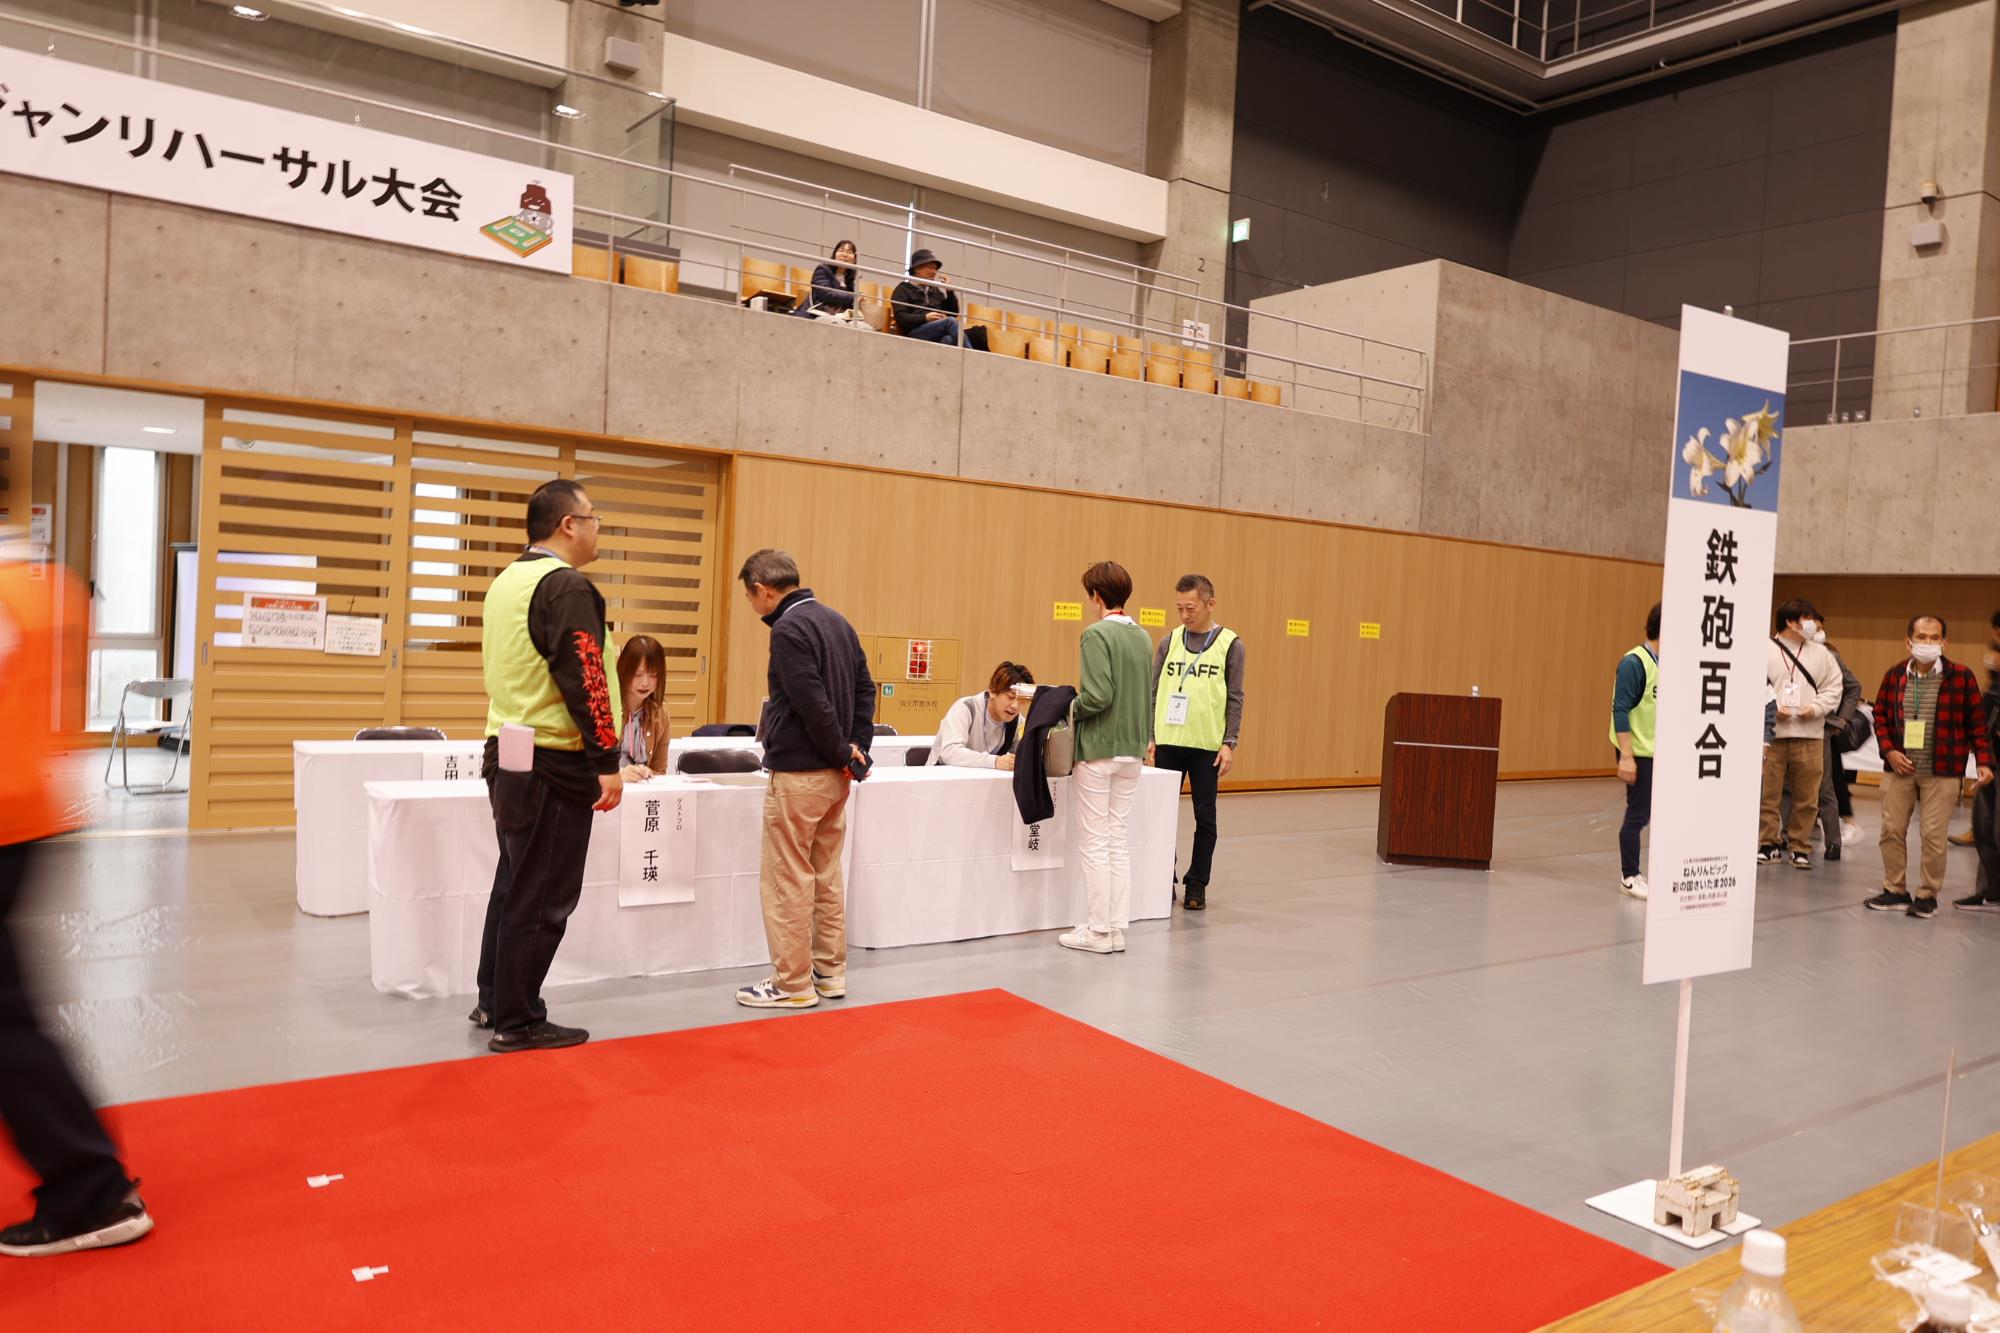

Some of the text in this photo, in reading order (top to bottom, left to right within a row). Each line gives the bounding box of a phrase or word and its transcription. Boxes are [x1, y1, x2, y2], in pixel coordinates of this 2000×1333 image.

[0, 83, 463, 222] ャンリハーサル大会
[1197, 257, 1206, 273] 2
[1695, 528, 1738, 779] 鉄砲百合
[1167, 661, 1220, 679] STAFF
[642, 800, 660, 882] 菅原 千瑛
[1027, 823, 1041, 851] 堂岐
[1683, 863, 1728, 878] ねんりんピック
[1672, 876, 1737, 893] 彩の国さいたま2026
